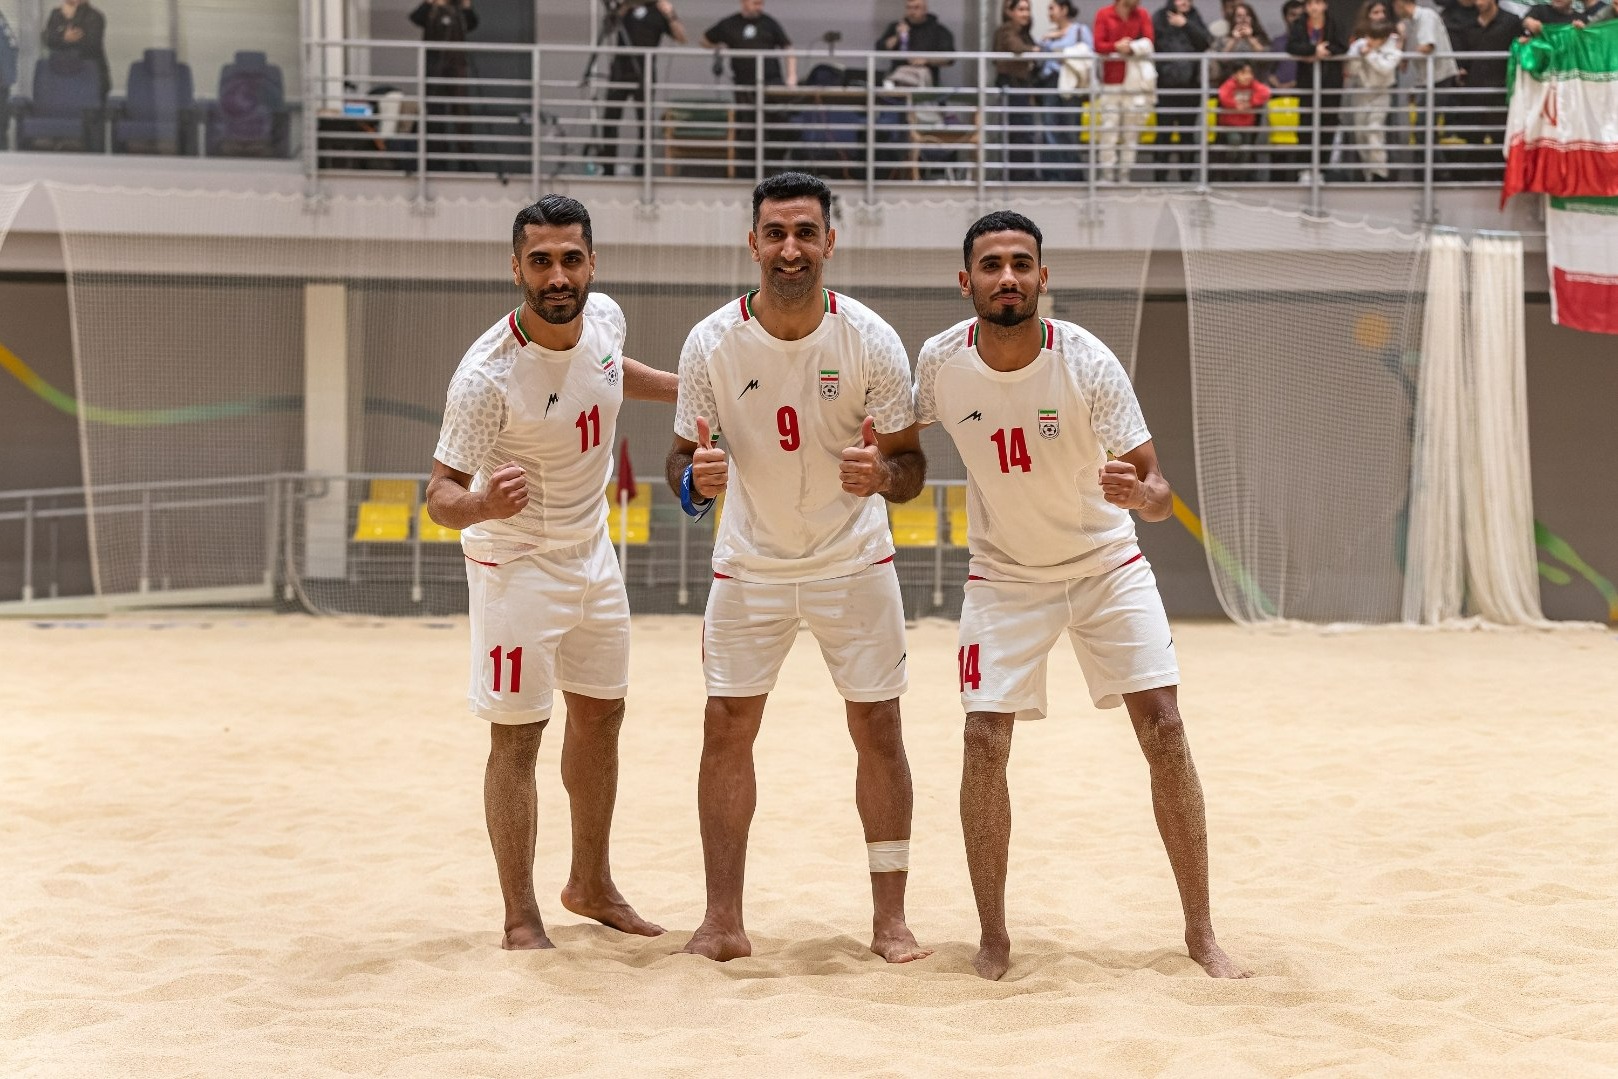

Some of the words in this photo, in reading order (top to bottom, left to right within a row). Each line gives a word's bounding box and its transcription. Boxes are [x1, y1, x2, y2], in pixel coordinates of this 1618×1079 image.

[575, 404, 601, 453] 11
[776, 405, 801, 451] 9
[990, 427, 1032, 474] 14
[489, 645, 523, 693] 11
[957, 643, 982, 693] 14
